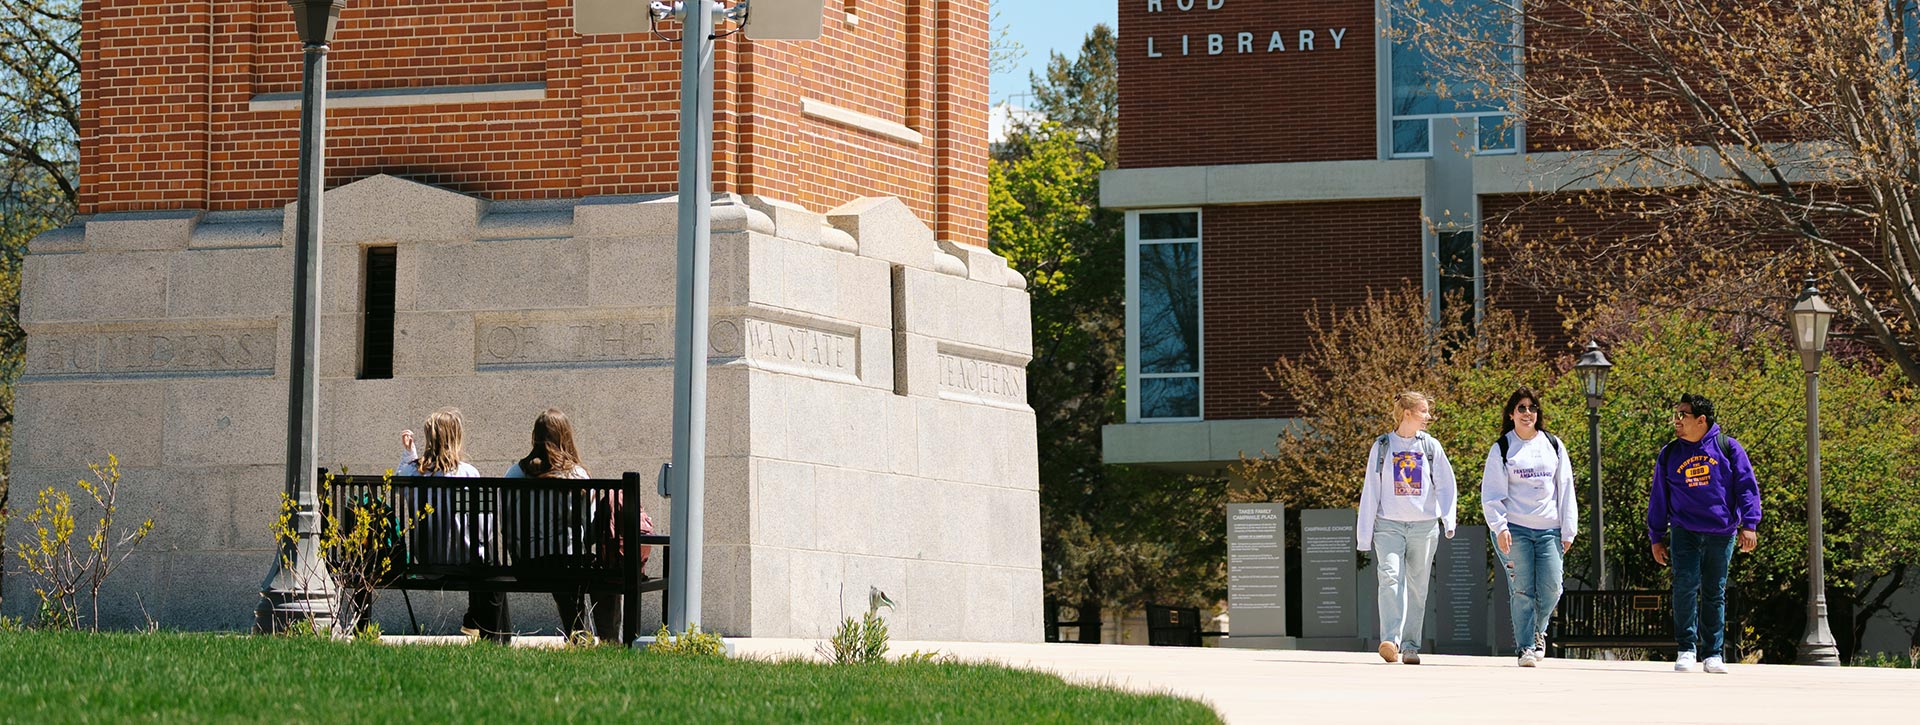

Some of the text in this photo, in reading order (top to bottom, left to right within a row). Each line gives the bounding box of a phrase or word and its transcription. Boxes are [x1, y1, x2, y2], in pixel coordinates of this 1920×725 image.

[1147, 28, 1346, 58] LIBRARY
[47, 333, 253, 370] BUILDERS
[487, 319, 843, 368] OF THE OWA STATE
[938, 355, 1020, 398] TEACHERS
[1676, 455, 1709, 474] PROPERTY
[1709, 457, 1718, 465] OF
[1395, 487, 1421, 495] IOWA
